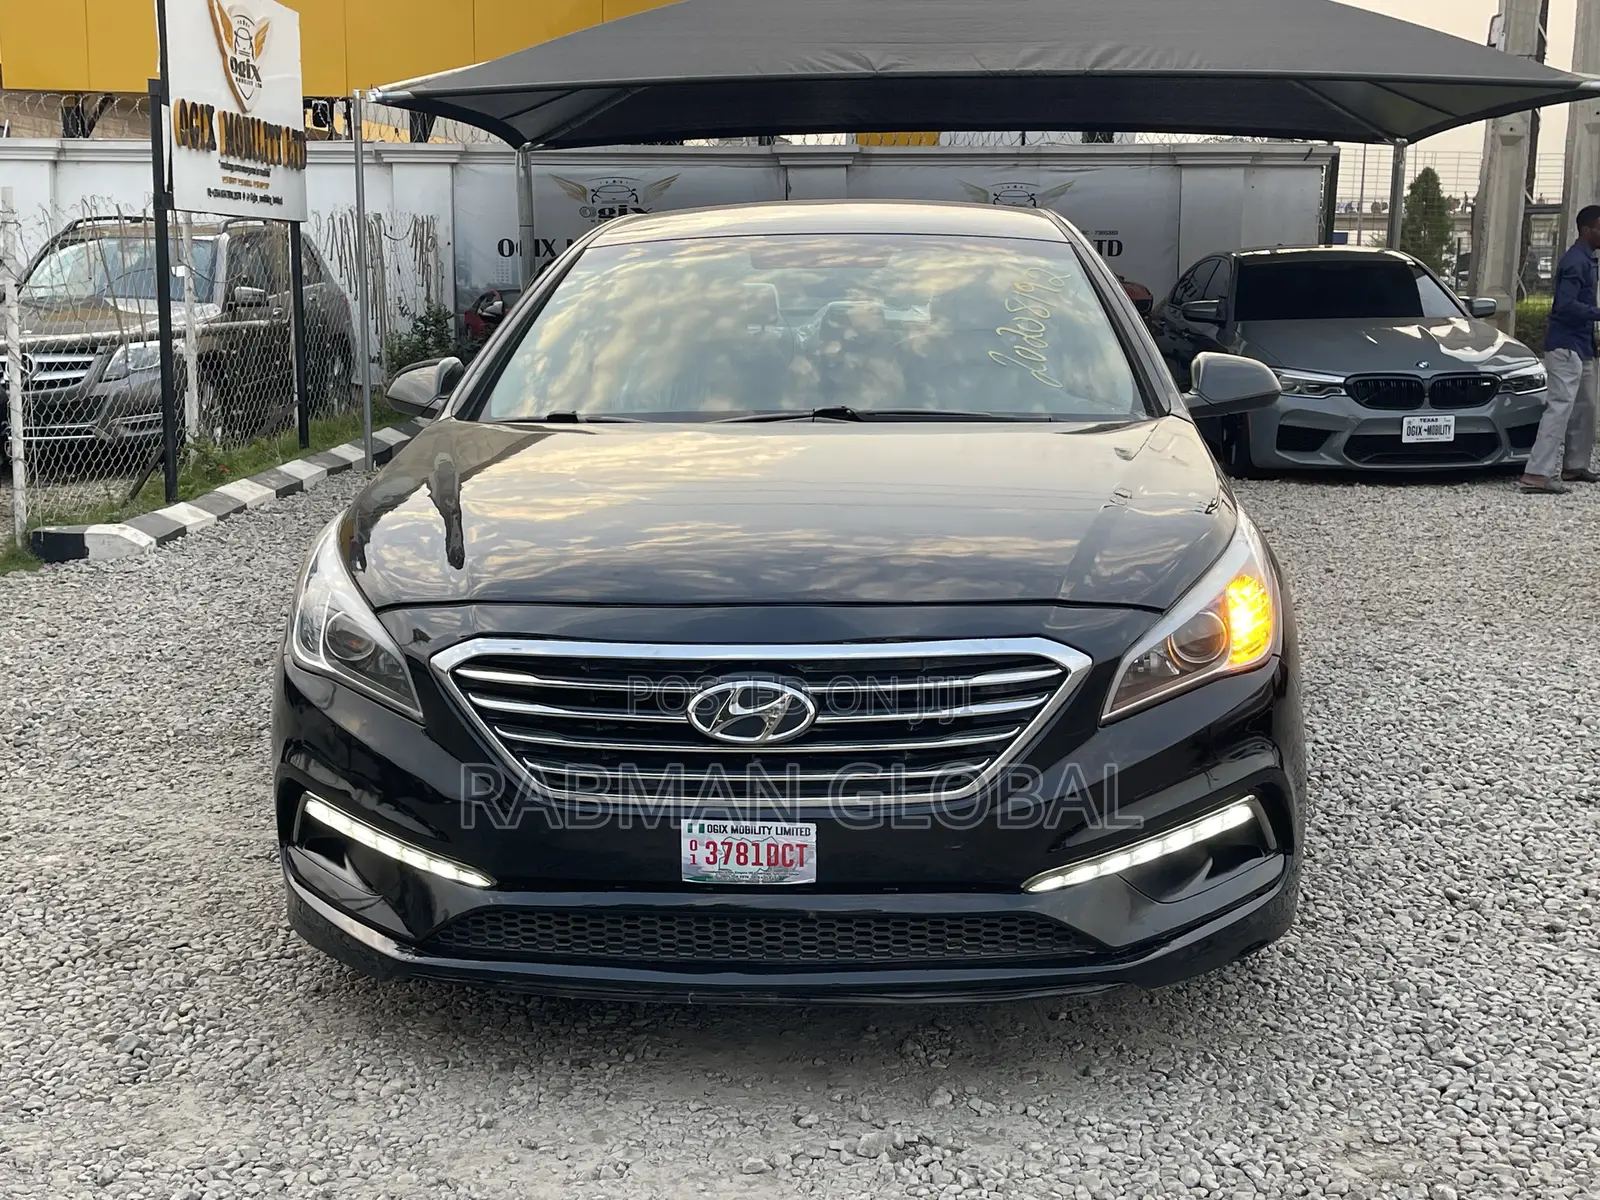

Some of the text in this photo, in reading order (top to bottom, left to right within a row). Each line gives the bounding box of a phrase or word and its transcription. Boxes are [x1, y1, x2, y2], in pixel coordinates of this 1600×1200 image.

[174, 98, 217, 152] OGIX
[1092, 239, 1123, 257] TD
[706, 823, 811, 837] OGIX MOBILITY LIMITED
[705, 841, 808, 867] 3781DCT
